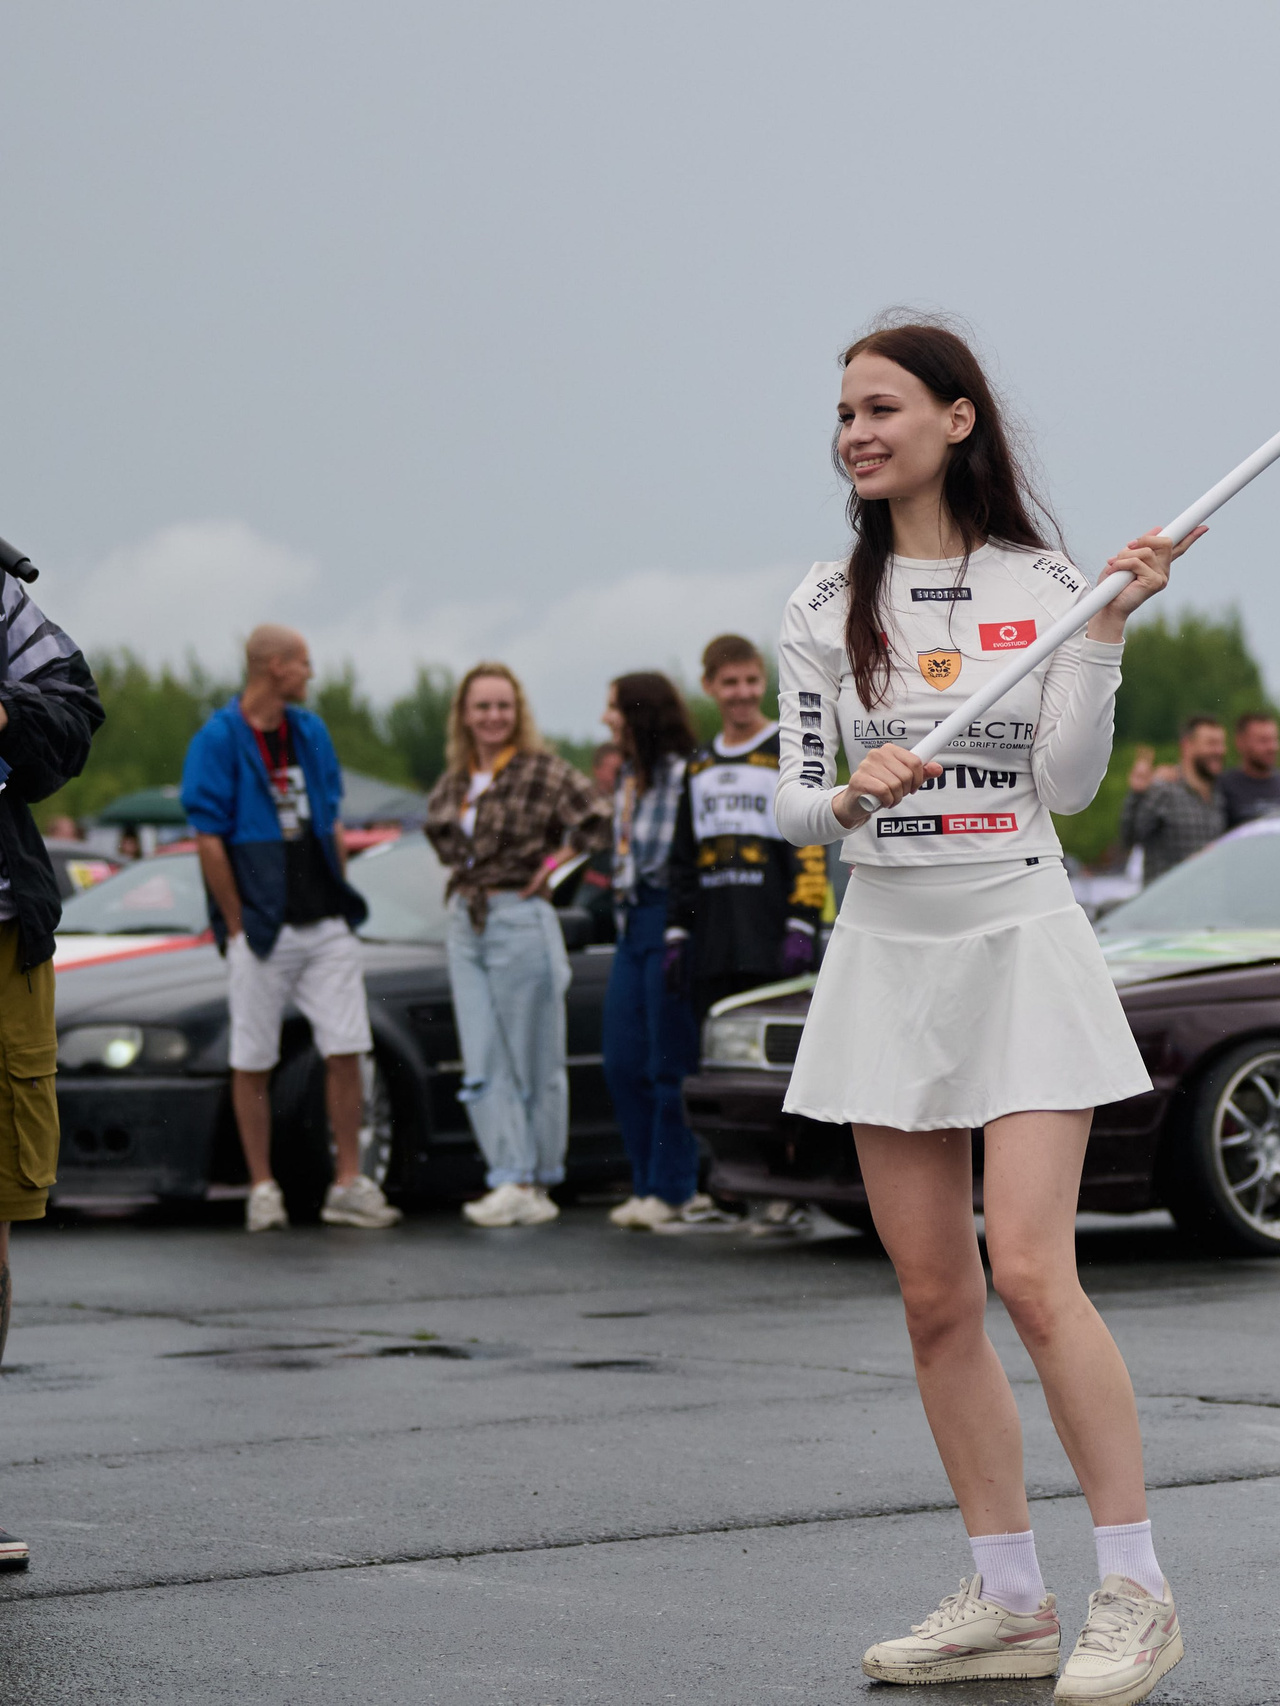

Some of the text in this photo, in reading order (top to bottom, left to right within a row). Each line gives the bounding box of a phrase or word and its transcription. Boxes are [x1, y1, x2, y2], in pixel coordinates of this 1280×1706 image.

[992, 640, 1028, 648] EVGOSTUDIO
[935, 720, 1034, 740] ECTR
[969, 741, 997, 749] DRIFT
[880, 817, 1013, 834] EVGO GOLD
